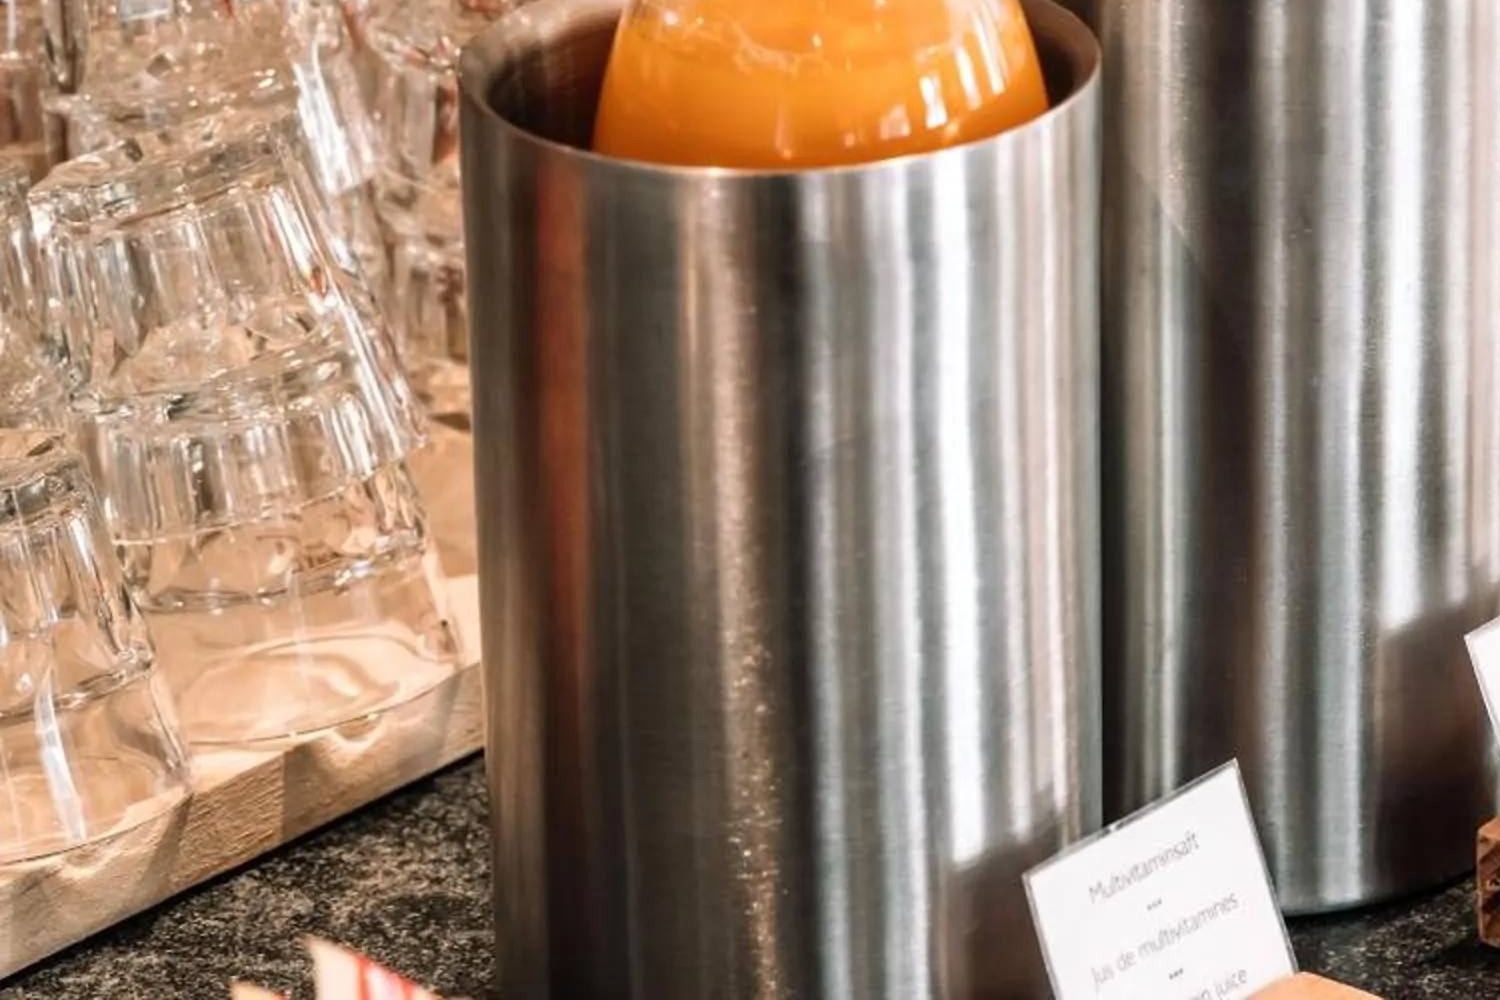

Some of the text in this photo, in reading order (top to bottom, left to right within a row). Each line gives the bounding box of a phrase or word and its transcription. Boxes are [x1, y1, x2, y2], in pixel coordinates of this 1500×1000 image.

[1091, 967, 1115, 993] Jus
[1116, 951, 1136, 972] de
[1215, 969, 1248, 1000] juice
